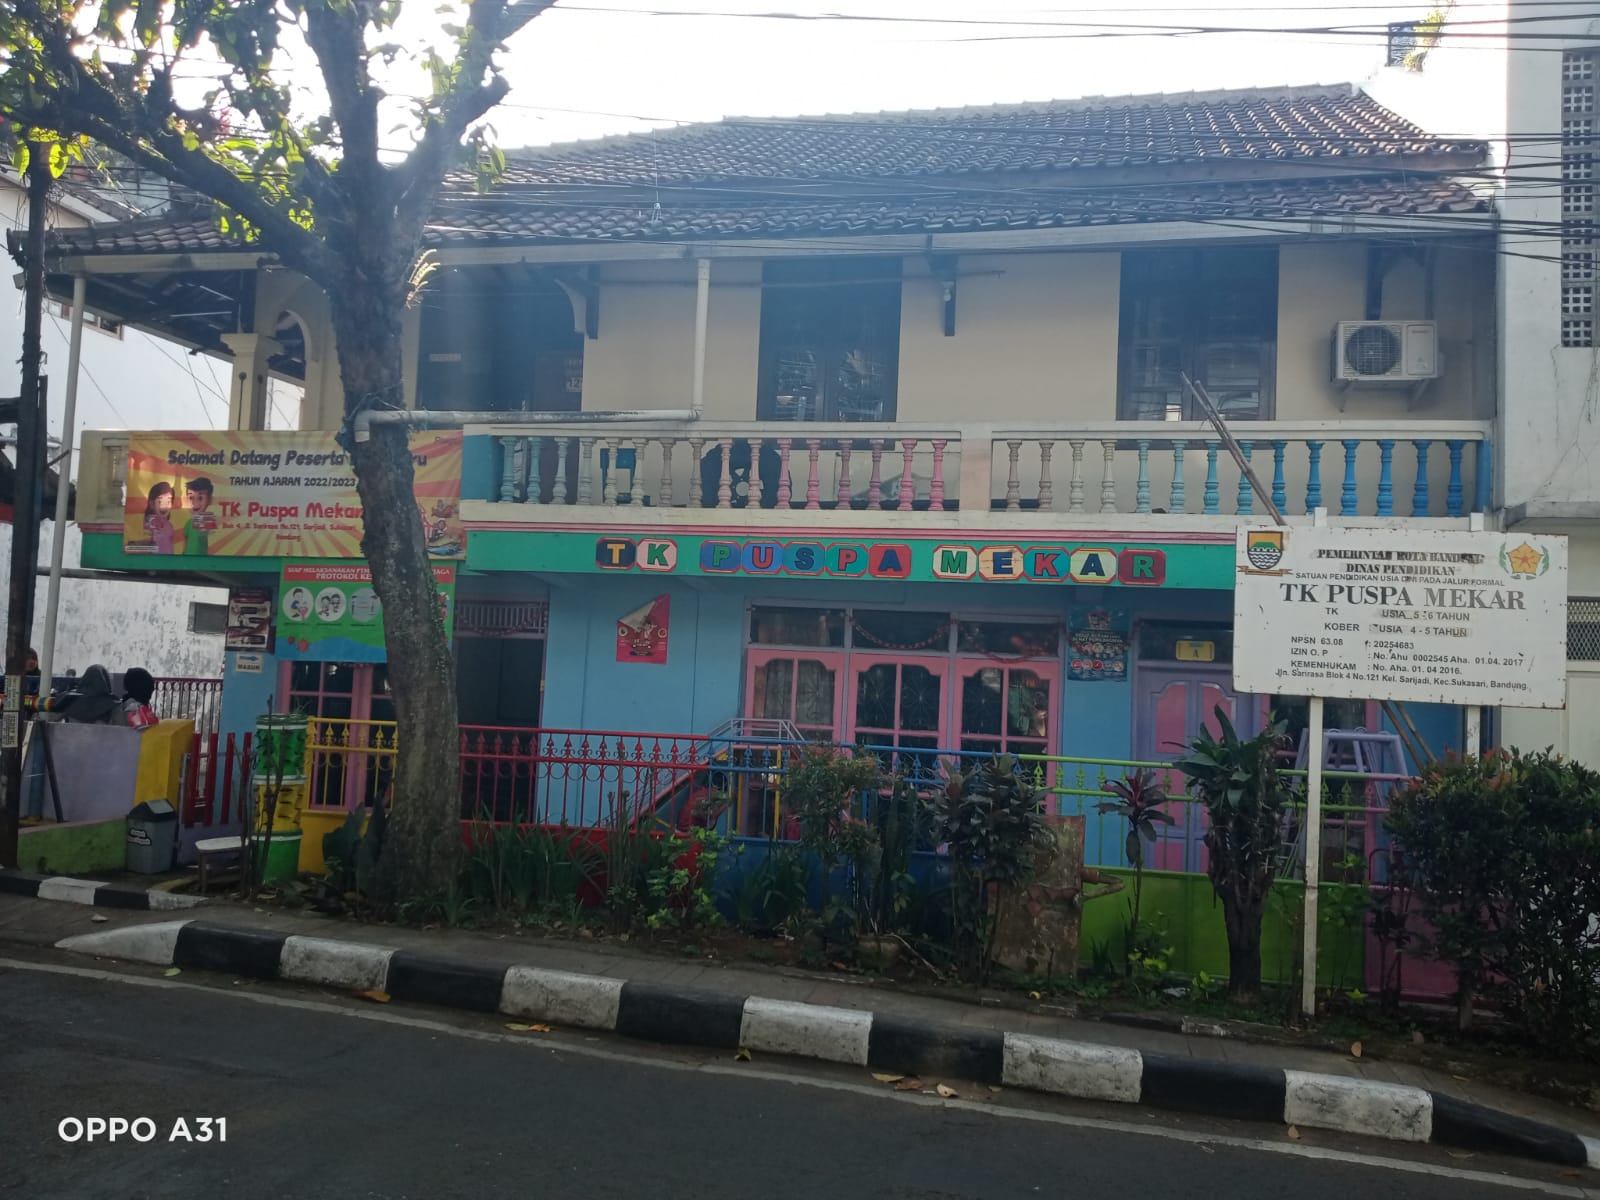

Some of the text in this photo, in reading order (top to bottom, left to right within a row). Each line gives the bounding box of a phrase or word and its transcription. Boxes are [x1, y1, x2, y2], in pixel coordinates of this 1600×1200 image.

[168, 450, 427, 471] Selamat Datang Peserta ru
[229, 477, 356, 487] TAHUN AJARAN 2022/2023
[219, 502, 363, 522] TK Puspa Mekar
[606, 543, 1154, 578] TK PUSPA MEKAR
[1345, 563, 1456, 576] DINAS PENDIDIKAN
[1295, 572, 1328, 580] SATUAN
[1329, 573, 1378, 581] PENDIDIKAN
[1419, 576, 1441, 584] PADA
[1442, 577, 1469, 585] JALUR
[1471, 578, 1505, 586] FORMAL
[1280, 583, 1527, 610] TK PUSPA MEKAR
[1325, 607, 1338, 615] TK
[1382, 608, 1406, 618] USIA
[1428, 611, 1433, 619] 6
[1436, 612, 1470, 621] TAHUN
[1324, 622, 1360, 632] KOBER
[1379, 624, 1403, 633] USIA
[1410, 626, 1417, 634] 4
[1424, 627, 1431, 635] 5
[1433, 627, 1467, 637] TAHUN
[1291, 636, 1316, 645] NPSN
[1290, 648, 1308, 656] IZIN
[1322, 649, 1329, 657] P
[1373, 652, 1388, 660] No.
[1390, 652, 1408, 661] Ahu
[1412, 654, 1449, 663] 0002545
[1502, 657, 1524, 667] 2017
[1290, 660, 1357, 670] KEMENHUKAM
[1372, 663, 1386, 671] No.
[1426, 665, 1437, 673] 04
[1326, 671, 1344, 679] Blok
[1345, 671, 1351, 679] 4
